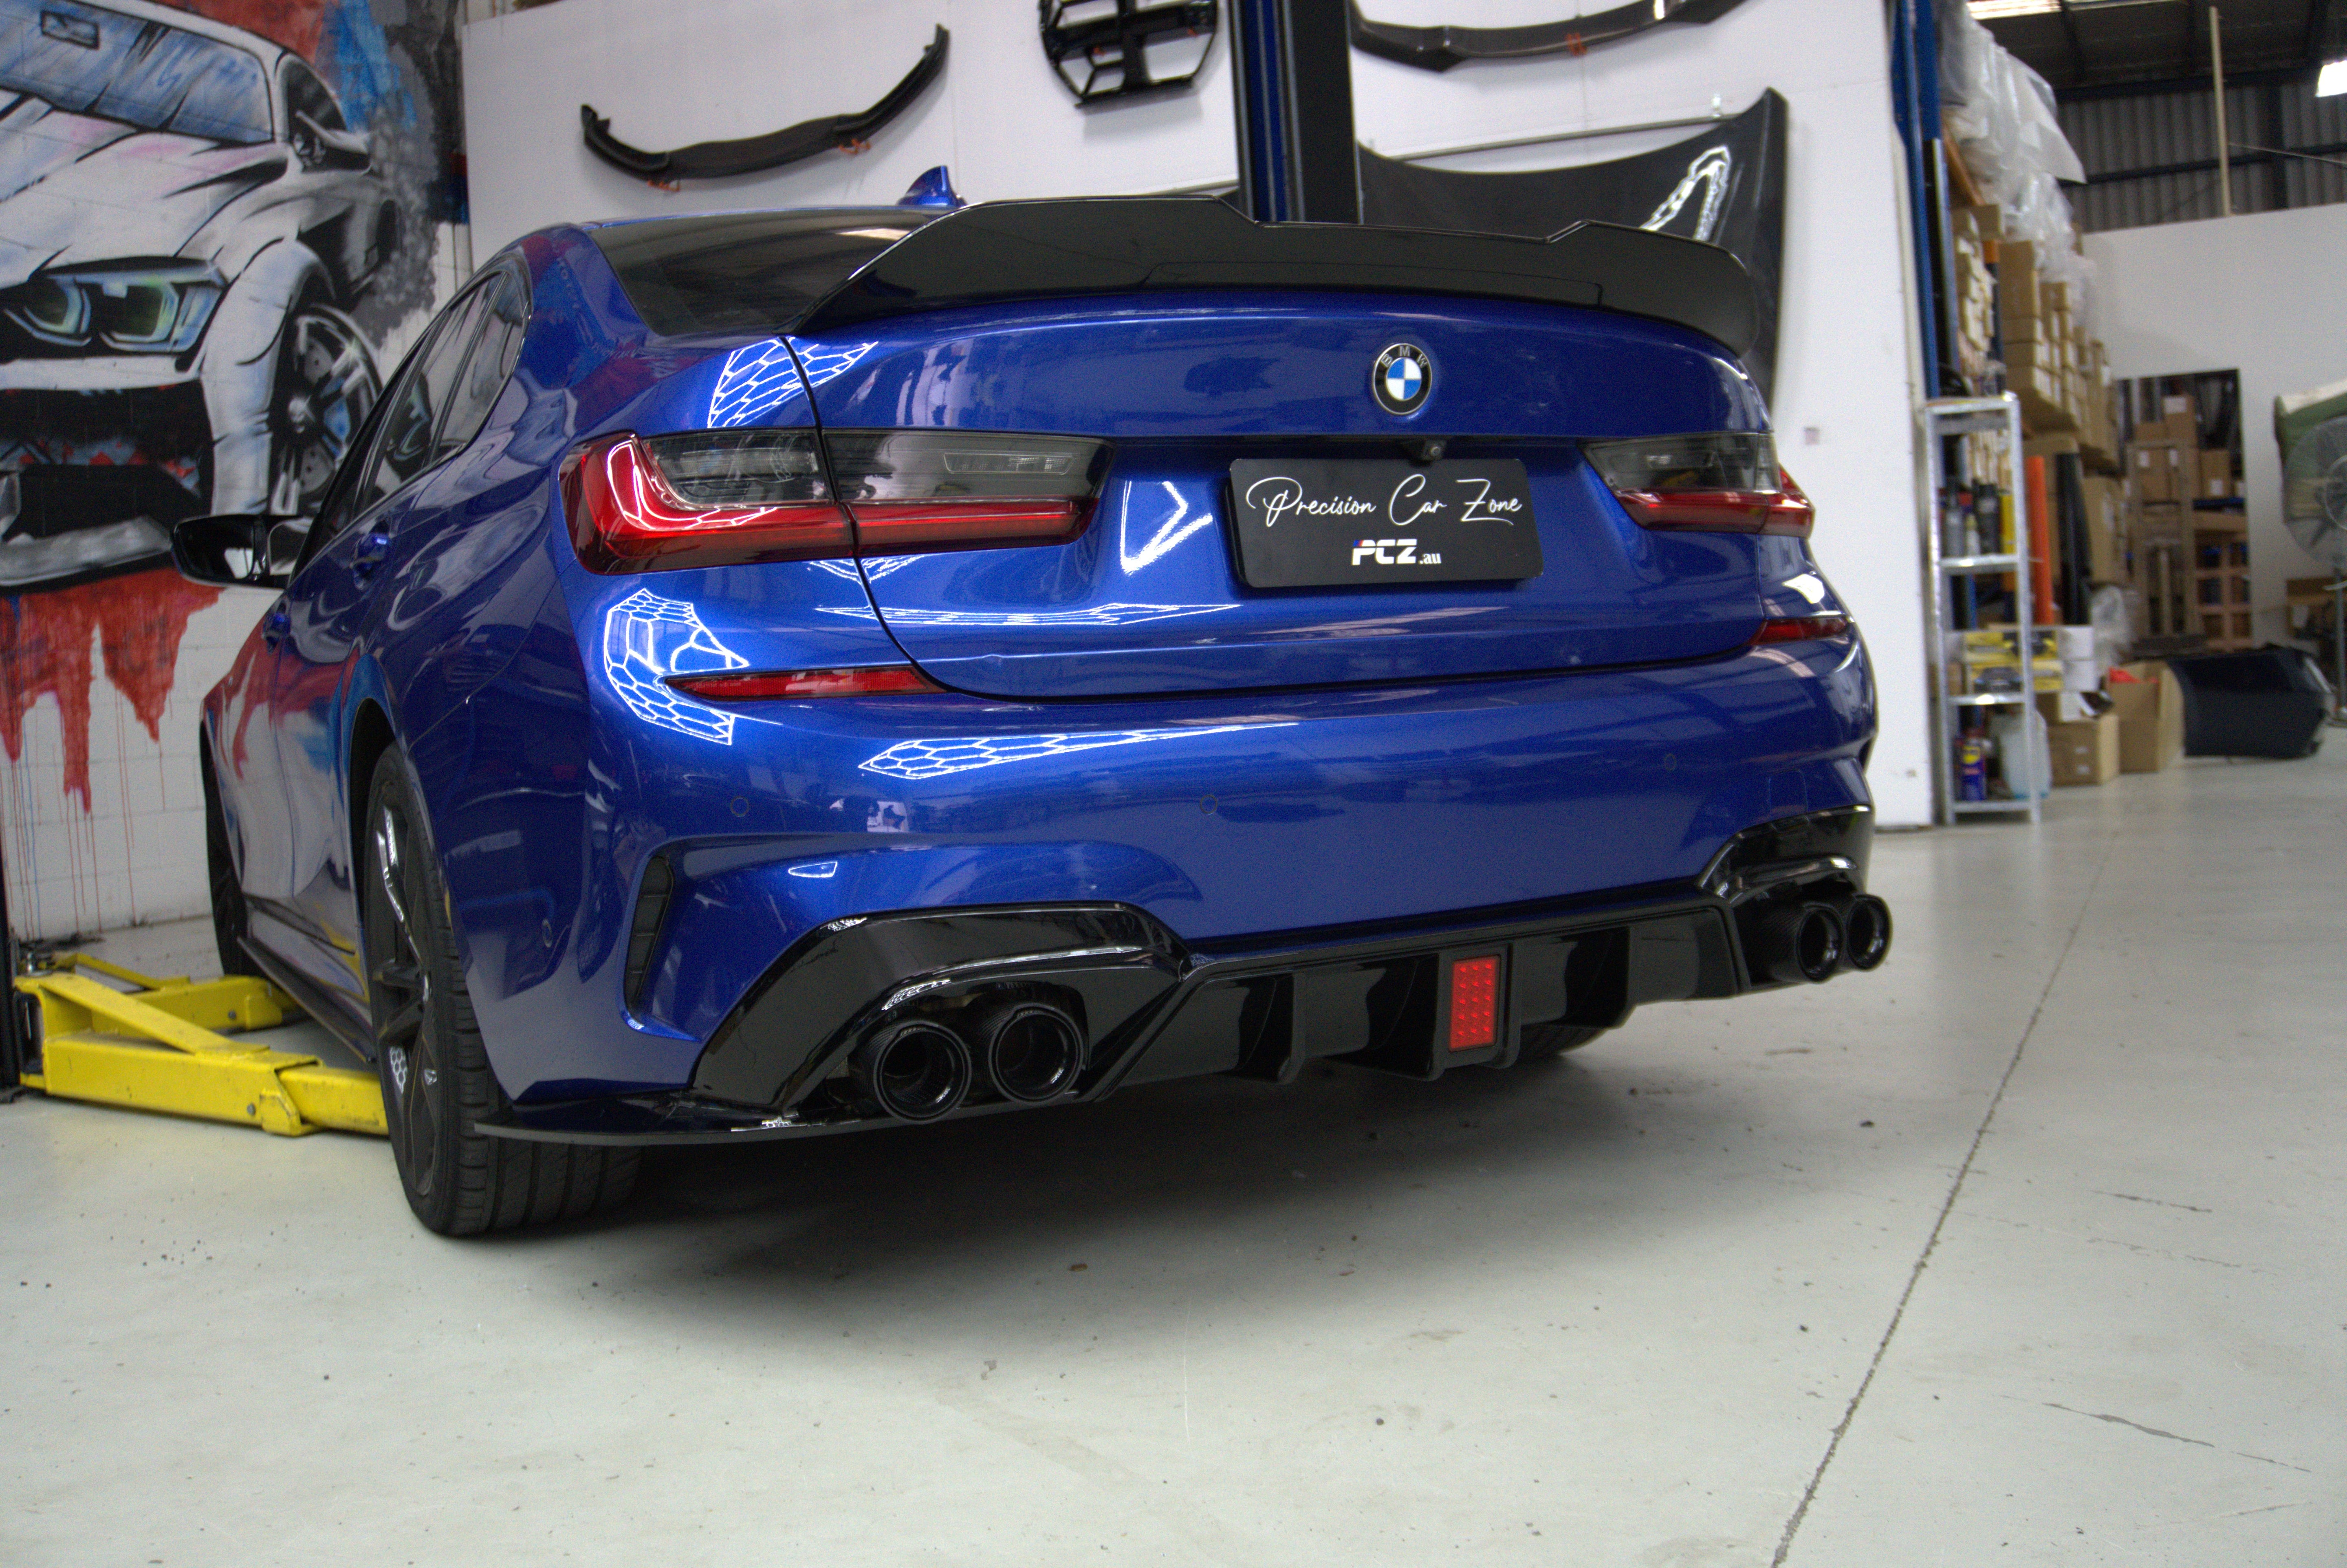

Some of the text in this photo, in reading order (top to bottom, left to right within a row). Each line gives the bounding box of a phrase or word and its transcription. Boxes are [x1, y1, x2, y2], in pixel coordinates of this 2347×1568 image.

[1380, 345, 1428, 368] BMW
[1245, 473, 1523, 528] Precision Car Zone
